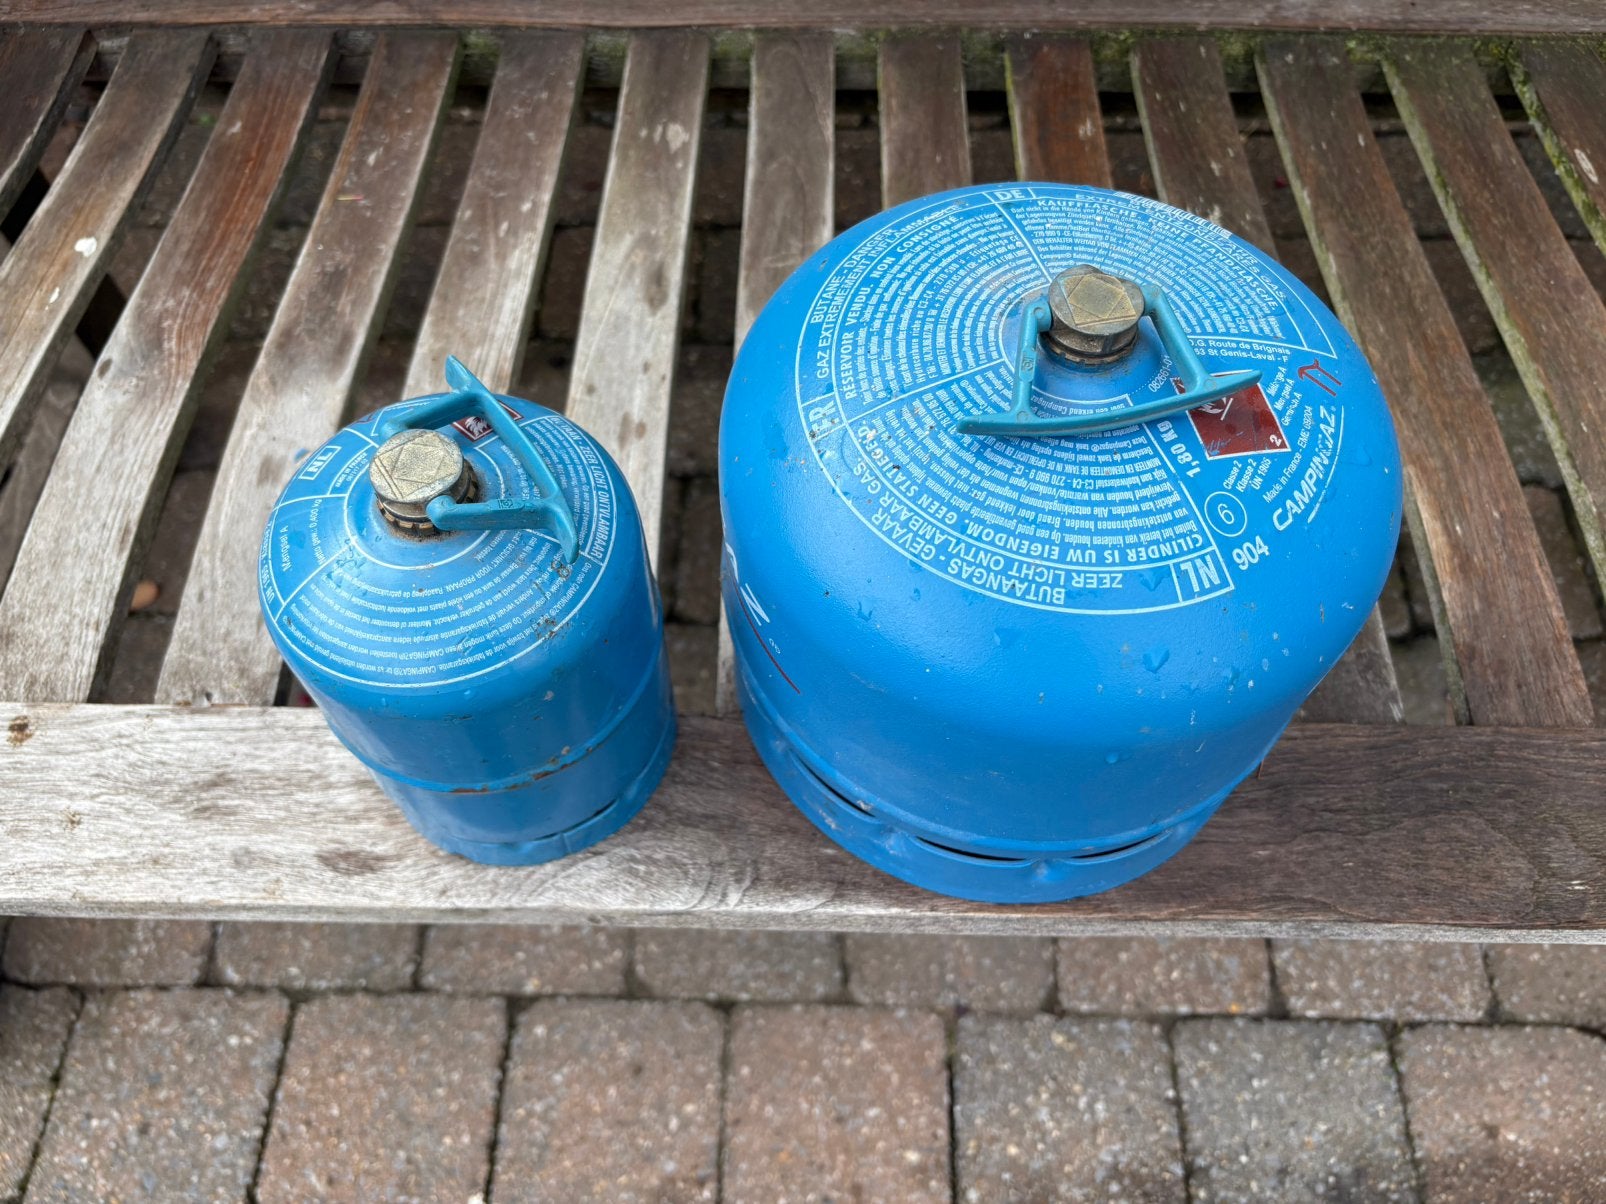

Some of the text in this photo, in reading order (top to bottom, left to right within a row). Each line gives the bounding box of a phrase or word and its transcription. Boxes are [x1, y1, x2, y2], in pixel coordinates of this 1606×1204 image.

[991, 188, 1026, 200] DE
[1075, 193, 1142, 211] EXTREM
[888, 213, 966, 253] CONSIGNÉ.
[1035, 199, 1144, 220] KAUFFLASCHE.
[1146, 217, 1192, 238] KEINE
[1191, 238, 1283, 311] PFANDFLASCHE.
[807, 274, 848, 325] BUTANE
[840, 228, 898, 268] DANGER
[867, 256, 897, 277] NON
[816, 258, 874, 350] EXTREMEMENT
[844, 283, 874, 326] VENDU.
[1207, 348, 1218, 356] St
[1220, 349, 1276, 361] Genis-Laval
[1209, 339, 1238, 349] Route
[1252, 344, 1291, 356] Brignais
[816, 346, 830, 381] GAZ
[836, 329, 860, 403] RÉSERVOIR
[1278, 366, 1287, 374] A
[1285, 378, 1295, 386] A
[1293, 391, 1302, 400] A
[1157, 420, 1201, 478] 1,80 KG
[1269, 434, 1282, 447] 2
[302, 450, 336, 473] NL
[577, 444, 600, 465] ZEER
[589, 465, 608, 488] LICHT
[1223, 460, 1243, 490] Classe 2
[1235, 458, 1257, 493] Klasse 2
[1283, 454, 1303, 480] France
[967, 471, 981, 486] als
[979, 476, 1019, 501] wegnemen
[1050, 473, 1065, 486] 270
[1133, 479, 1174, 499] Verwijderd
[1251, 477, 1263, 491] UN
[1279, 476, 1289, 487] in
[1090, 491, 1104, 500] van
[1105, 489, 1134, 502] houden
[1262, 482, 1283, 503] Made
[916, 491, 959, 526] GEEN
[984, 494, 1016, 516] lekkend
[1016, 506, 1035, 522] door
[1017, 491, 1091, 517] ontstekingsbronnen
[1092, 506, 1109, 518] Alle
[1139, 500, 1155, 513] kan
[1172, 505, 1188, 518] van
[1217, 503, 1235, 525] 6
[588, 491, 610, 559] ONTVLAMBAAR
[848, 456, 1123, 588] ZEER LICHT ONTVLAMBAAR GAS.
[1036, 512, 1061, 528] Brand
[1062, 516, 1094, 531] houden.
[1096, 509, 1174, 531] ontstekingsbronnen
[869, 505, 937, 563] GEVAAR
[959, 516, 1059, 561] EIGENDOM.
[1091, 533, 1124, 547] kinderen
[278, 523, 292, 574] Mengsel A
[1065, 547, 1096, 563] UW
[1102, 549, 1120, 563] IS
[1124, 531, 1205, 562] CILINDER
[1231, 534, 1270, 571] 904
[946, 554, 1065, 606] BUTAANGAS
[1178, 552, 1221, 594] NL
[264, 584, 276, 603] UN
